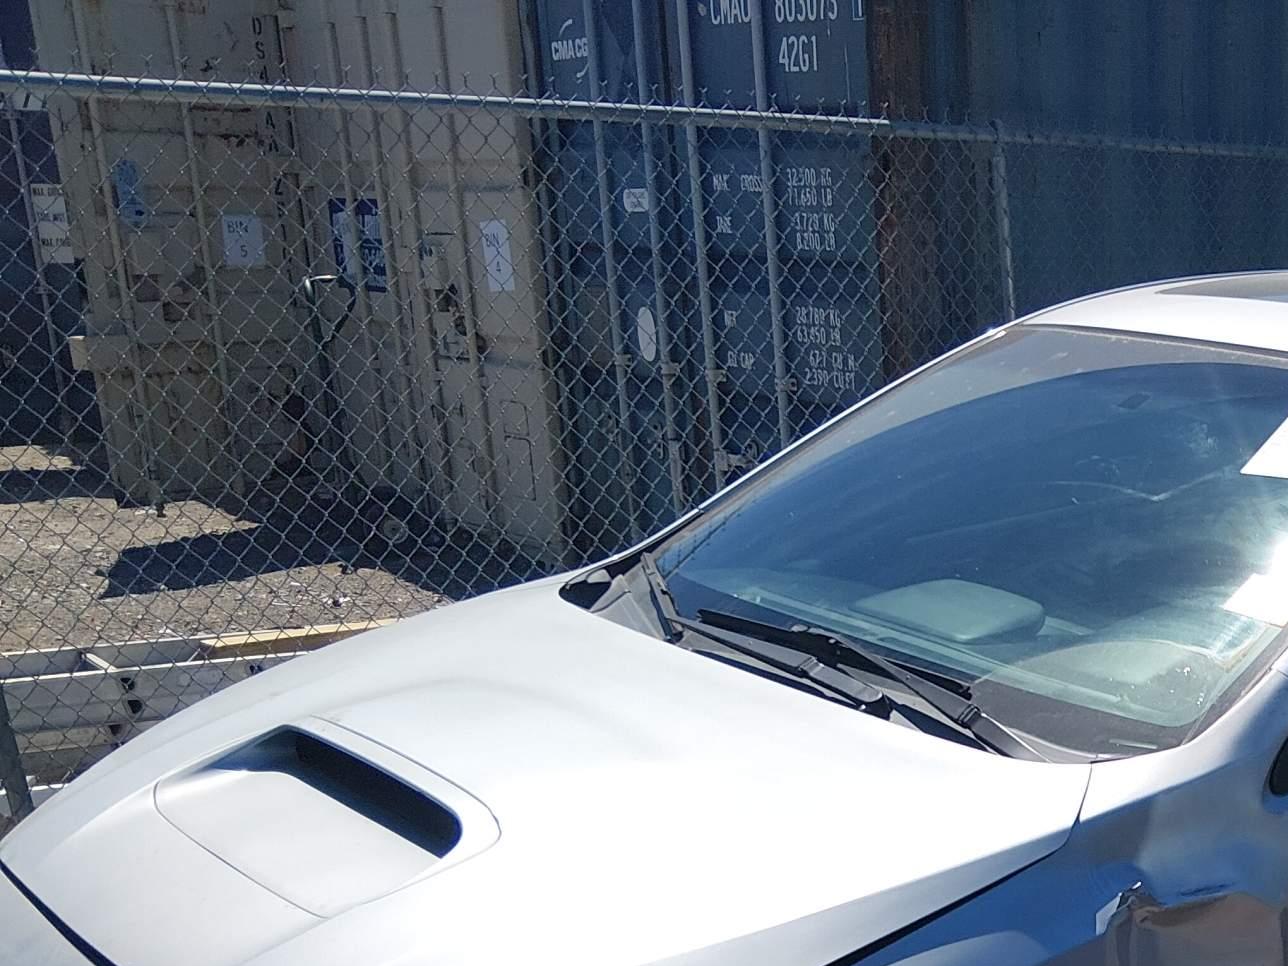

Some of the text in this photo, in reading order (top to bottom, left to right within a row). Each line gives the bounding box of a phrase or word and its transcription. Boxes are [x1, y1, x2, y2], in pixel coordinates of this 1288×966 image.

[551, 37, 589, 61] CMA CG
[779, 35, 818, 72] 42G1
[227, 221, 249, 234] BIN
[240, 245, 248, 257] 5
